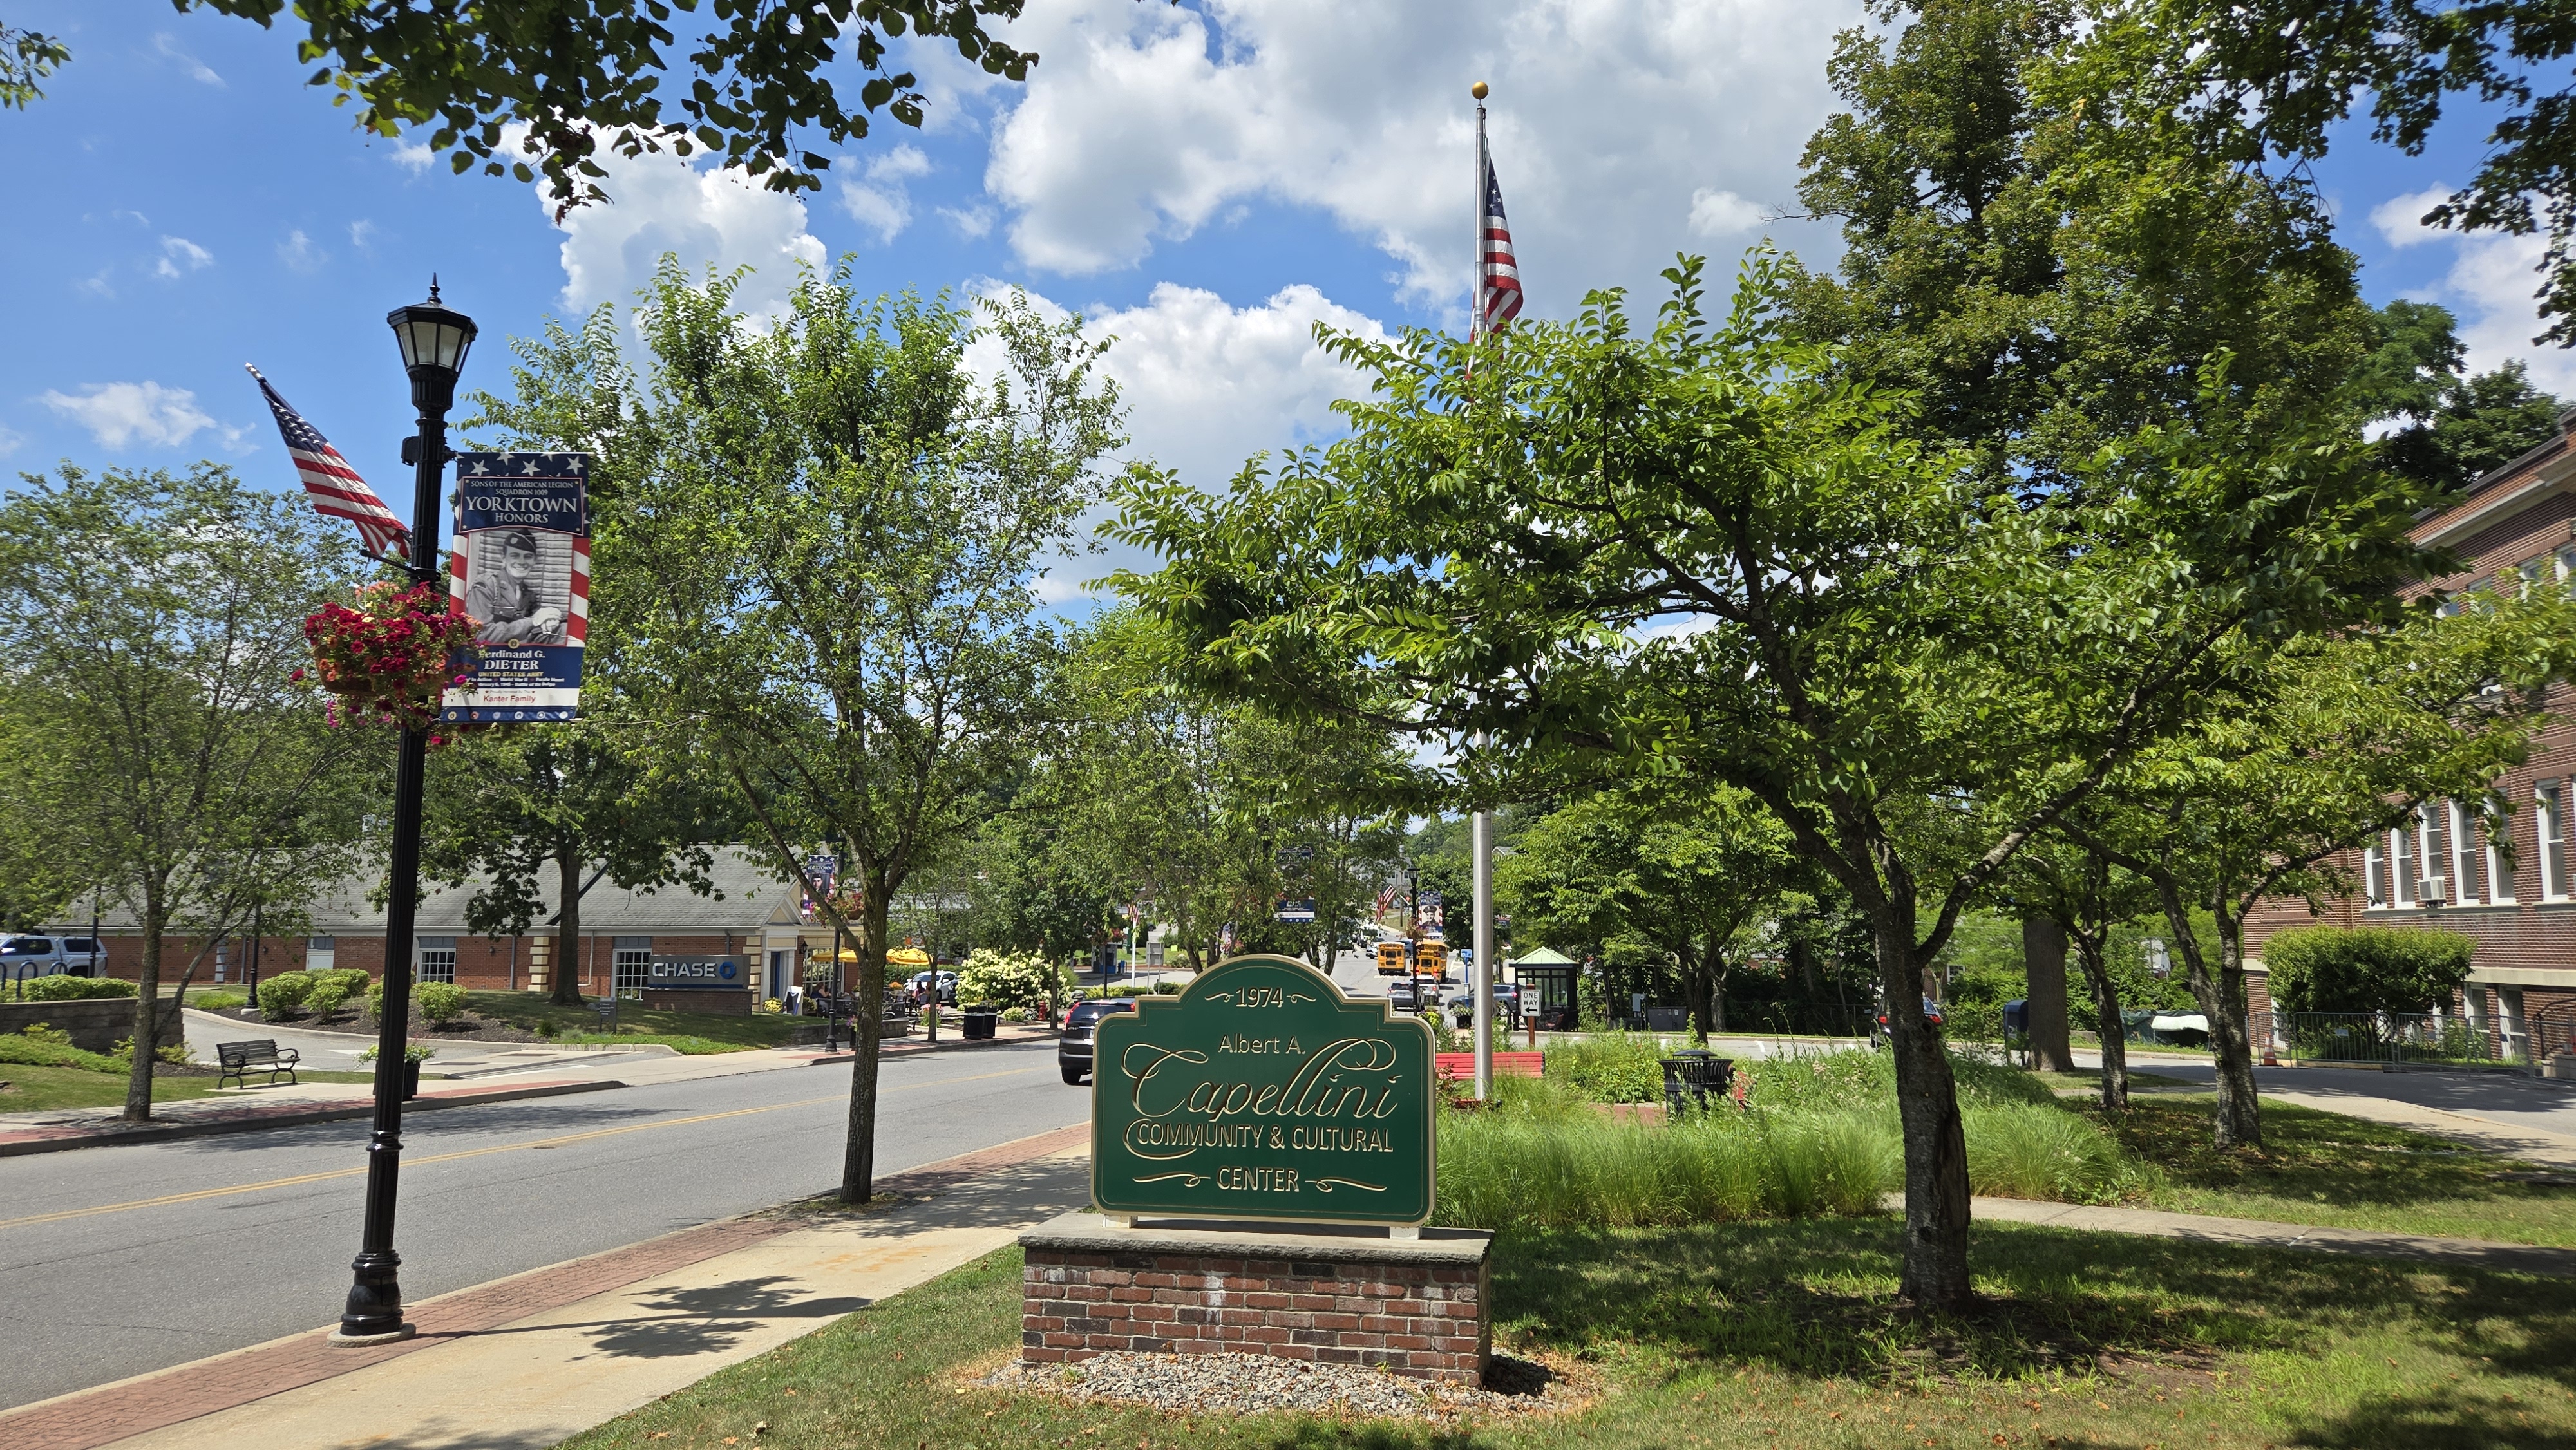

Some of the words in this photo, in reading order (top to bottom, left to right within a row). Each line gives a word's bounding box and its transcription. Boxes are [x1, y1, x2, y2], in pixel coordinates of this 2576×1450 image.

[495, 488, 533, 496] SQUADRON
[465, 496, 578, 513] YORKTOWN
[495, 513, 549, 523] HONORS
[484, 660, 539, 670] DIETER
[652, 962, 716, 977] CHASE
[1235, 986, 1284, 1008] 1974
[1218, 1033, 1280, 1054] Albert
[1285, 1035, 1306, 1055] A.
[1121, 1039, 1403, 1122] Capellini
[1137, 1122, 1263, 1149] COMMUNITY
[1269, 1125, 1285, 1149] &
[1291, 1125, 1394, 1153] CULTURAL
[1217, 1165, 1300, 1192] CENTER
